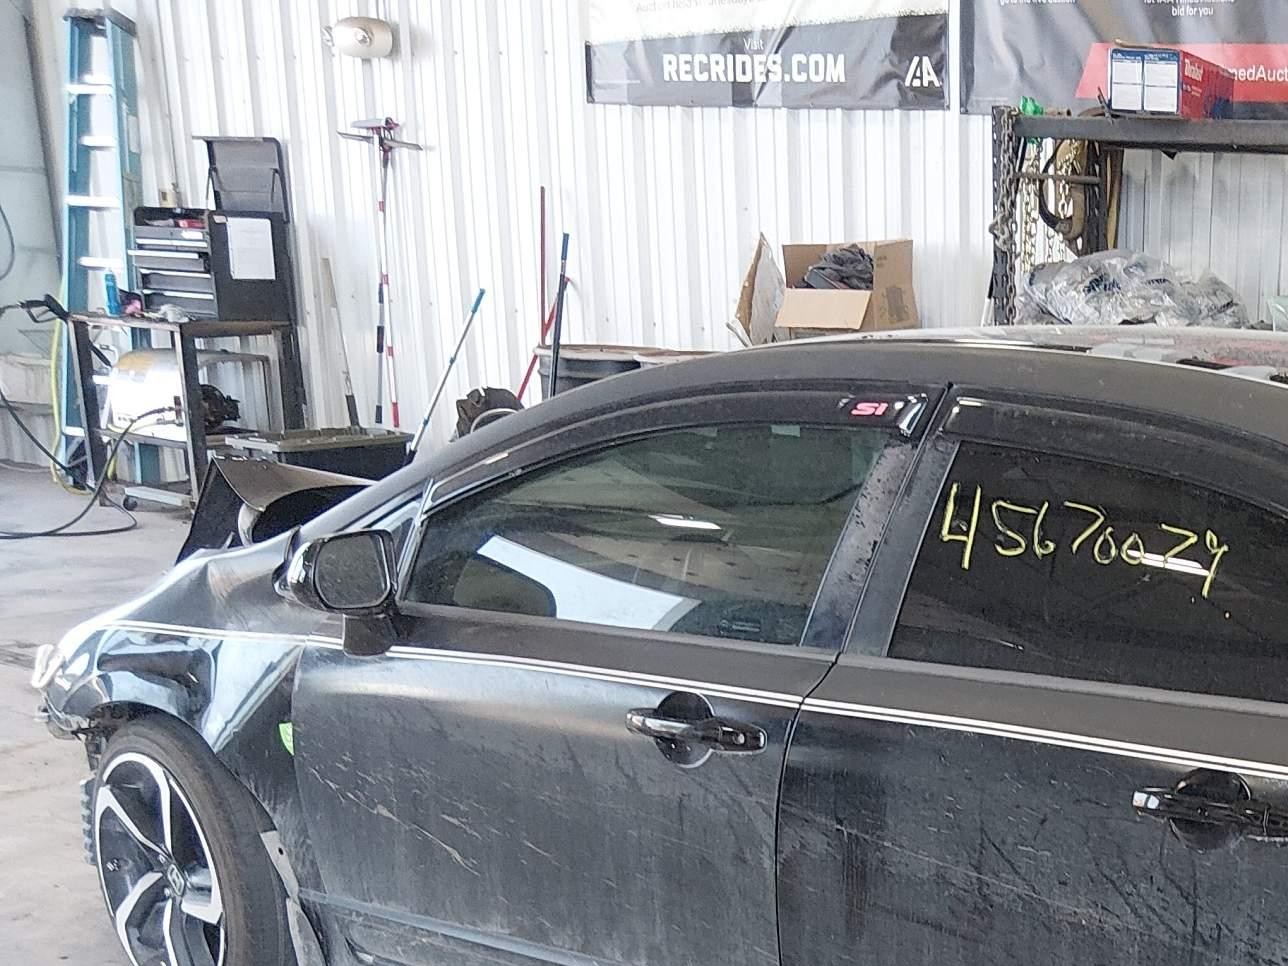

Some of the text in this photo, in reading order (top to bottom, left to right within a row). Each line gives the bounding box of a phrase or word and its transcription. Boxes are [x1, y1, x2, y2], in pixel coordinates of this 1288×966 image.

[1171, 6, 1214, 17] bid for you
[743, 38, 764, 50] Visit
[662, 53, 846, 83] RECRIDES.COM
[940, 482, 1229, 598] 45670079
